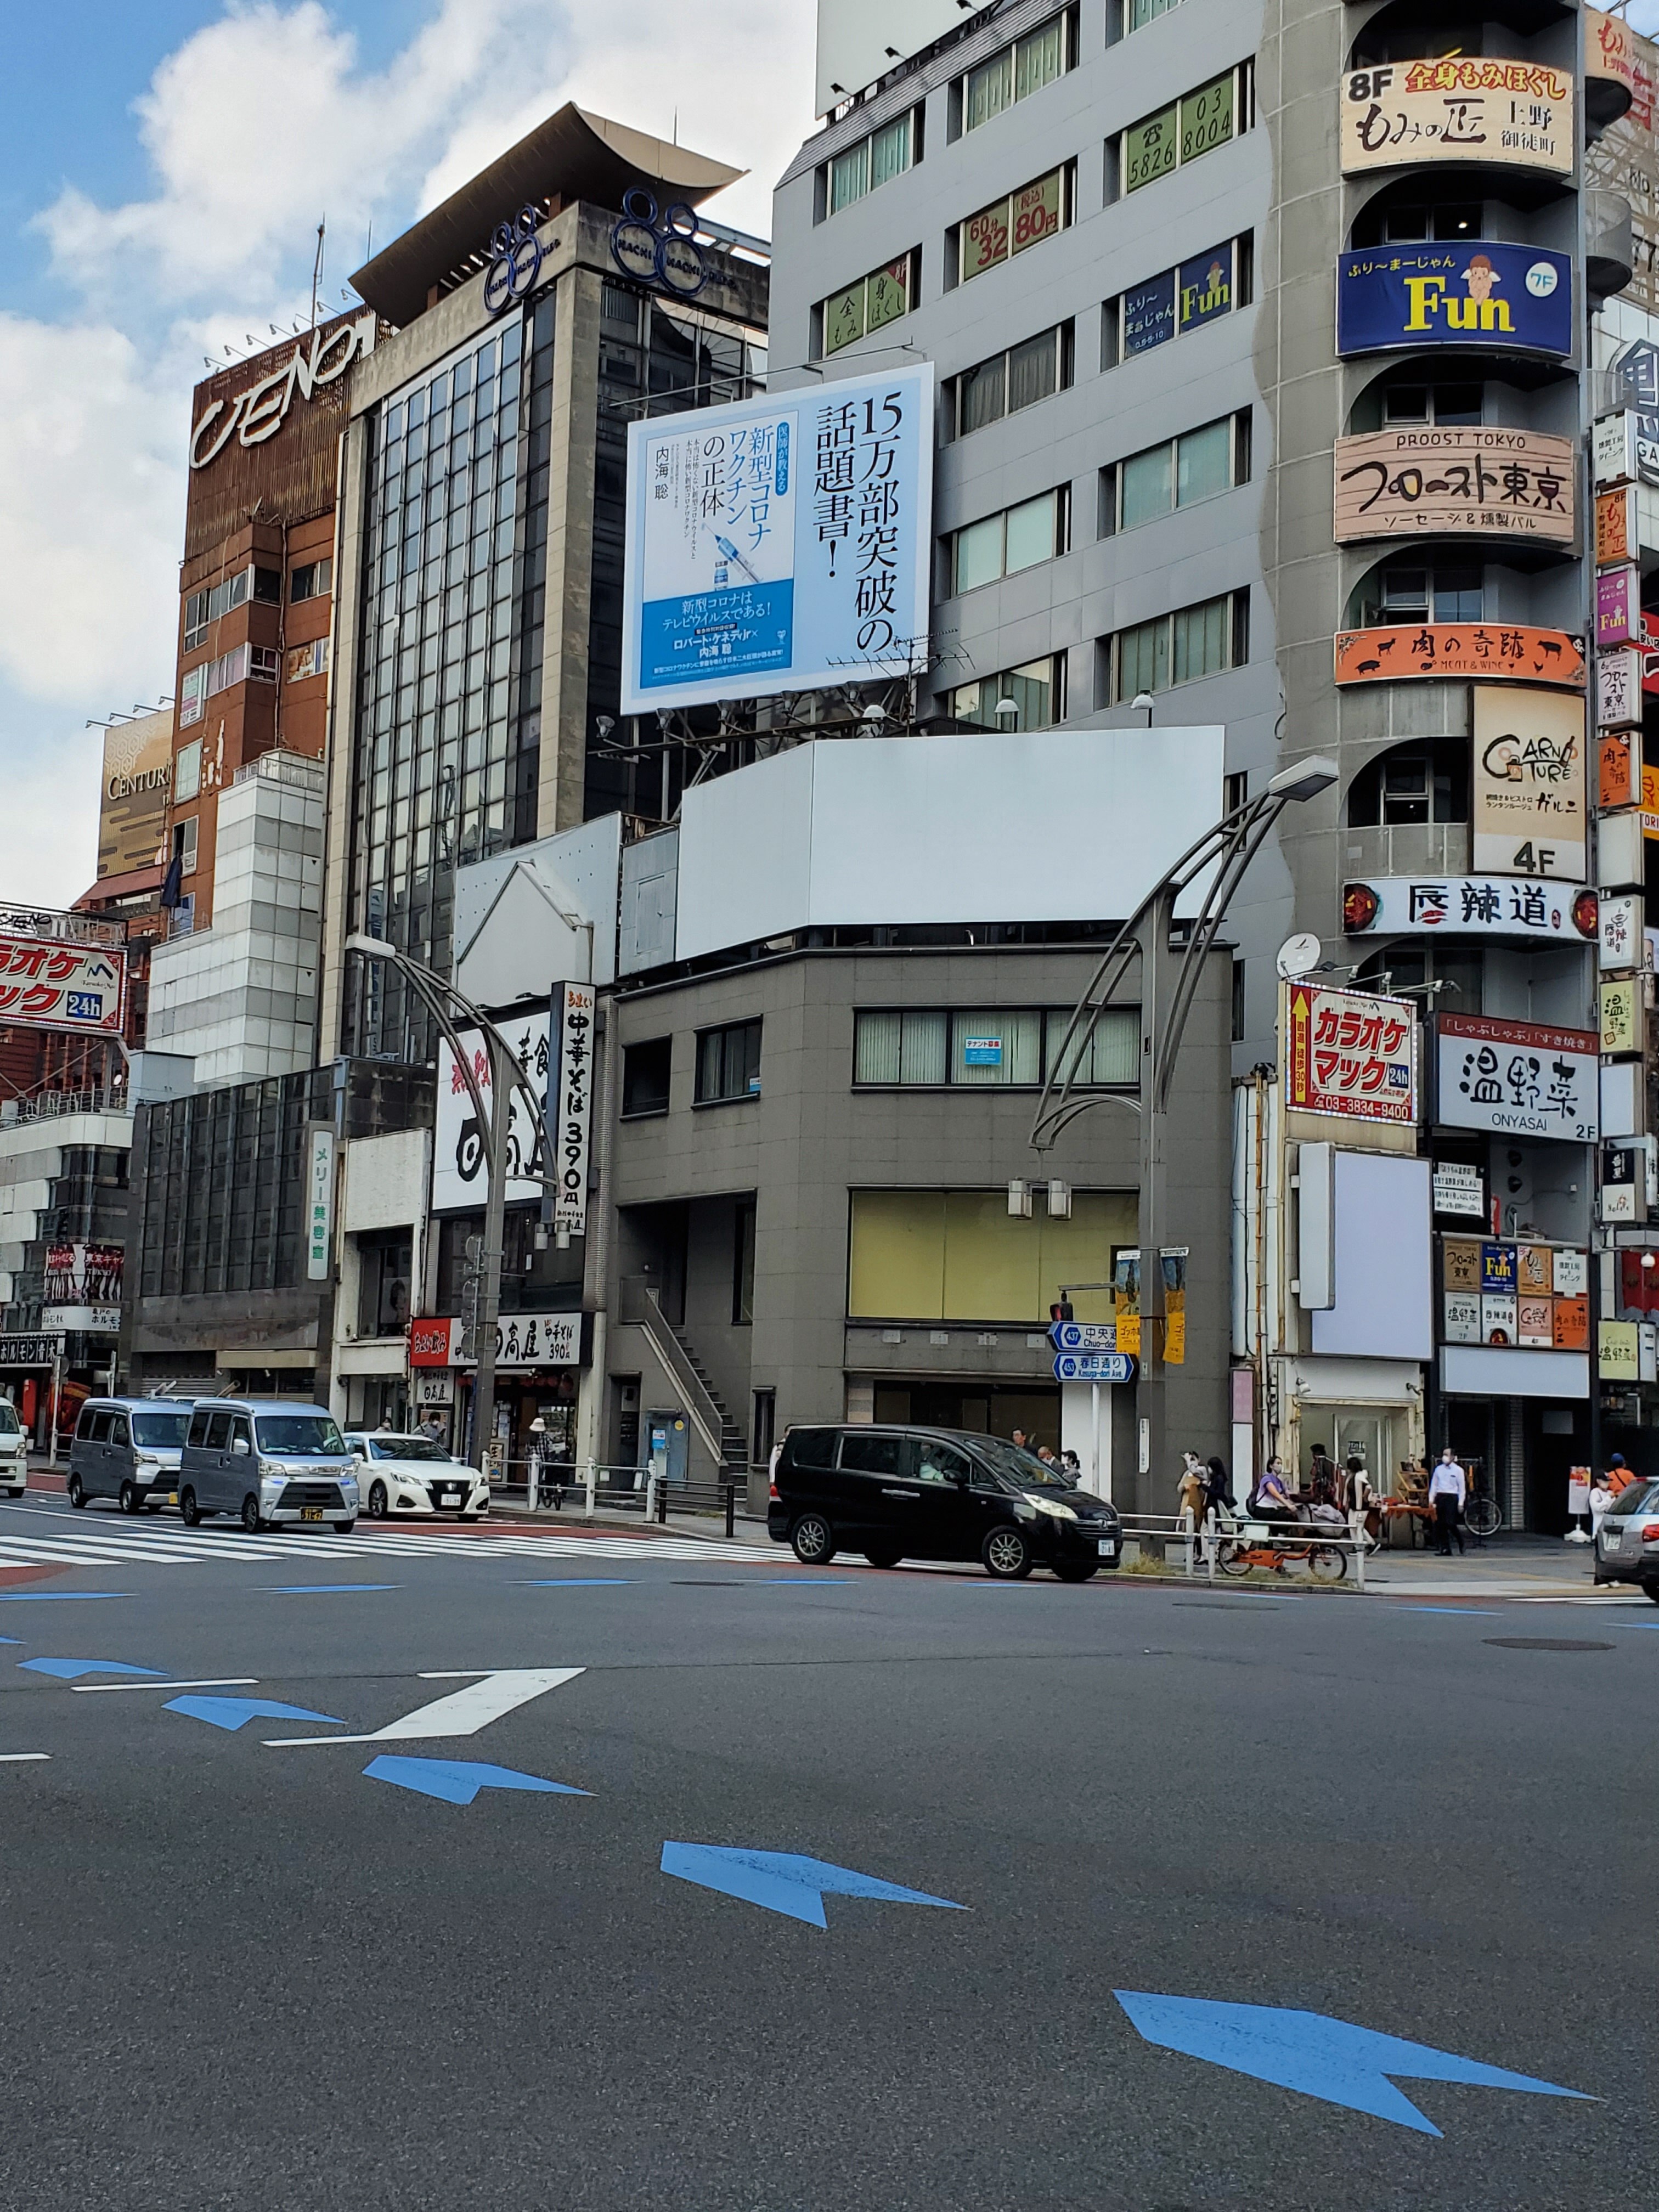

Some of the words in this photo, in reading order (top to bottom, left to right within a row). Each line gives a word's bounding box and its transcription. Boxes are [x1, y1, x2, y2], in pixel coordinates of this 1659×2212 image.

[1348, 67, 1395, 102] 8F
[1405, 62, 1566, 100] 全身もみほぐし
[1197, 87, 1221, 120] 03
[1501, 101, 1553, 131] 上野
[1356, 99, 1486, 151] もみの匠
[1130, 139, 1172, 184] 5826
[1183, 110, 1230, 156] 8004
[1501, 130, 1555, 156] 御徒町
[895, 262, 907, 280] 8F
[1531, 272, 1553, 288] 7F
[1181, 283, 1231, 324] Fun
[1403, 276, 1516, 332] Fun
[1397, 433, 1464, 449] PROOST
[1475, 433, 1526, 449] TOKYO
[777, 424, 788, 492] 医師が教える
[700, 436, 725, 518] の正体
[726, 430, 748, 525] ワクチン
[748, 425, 774, 552] 新型コロナ
[813, 400, 856, 578] 話題書!
[856, 391, 904, 654] 15万部突破の
[663, 602, 771, 631] テレビウイルスである!
[682, 591, 752, 615] 新型コロナは
[1600, 613, 1626, 631] Fun
[1412, 630, 1525, 659] 肉の奇跡
[1573, 638, 1586, 655] 5F
[1470, 661, 1477, 669] &
[1481, 661, 1504, 670] WINE
[1604, 693, 1624, 709] 東京
[1535, 792, 1577, 813] ガルニ
[1514, 842, 1555, 874] 4F
[68, 994, 101, 1017] 24h
[1313, 1007, 1410, 1056] カラオケ
[1314, 1049, 1389, 1093] マック
[1390, 1067, 1408, 1085] 24h
[1459, 1046, 1578, 1119] 温野菜
[1326, 1096, 1408, 1119] 03-3834-9400
[1492, 1113, 1547, 1131] ONYASAI
[1576, 1124, 1596, 1139] 2F
[1485, 1257, 1512, 1277] Fun
[1066, 1331, 1079, 1341] 437
[1079, 1370, 1110, 1380] Kasuga-dori
[1080, 1357, 1121, 1369] 春日通り
[424, 1383, 446, 1401] 日高屋
